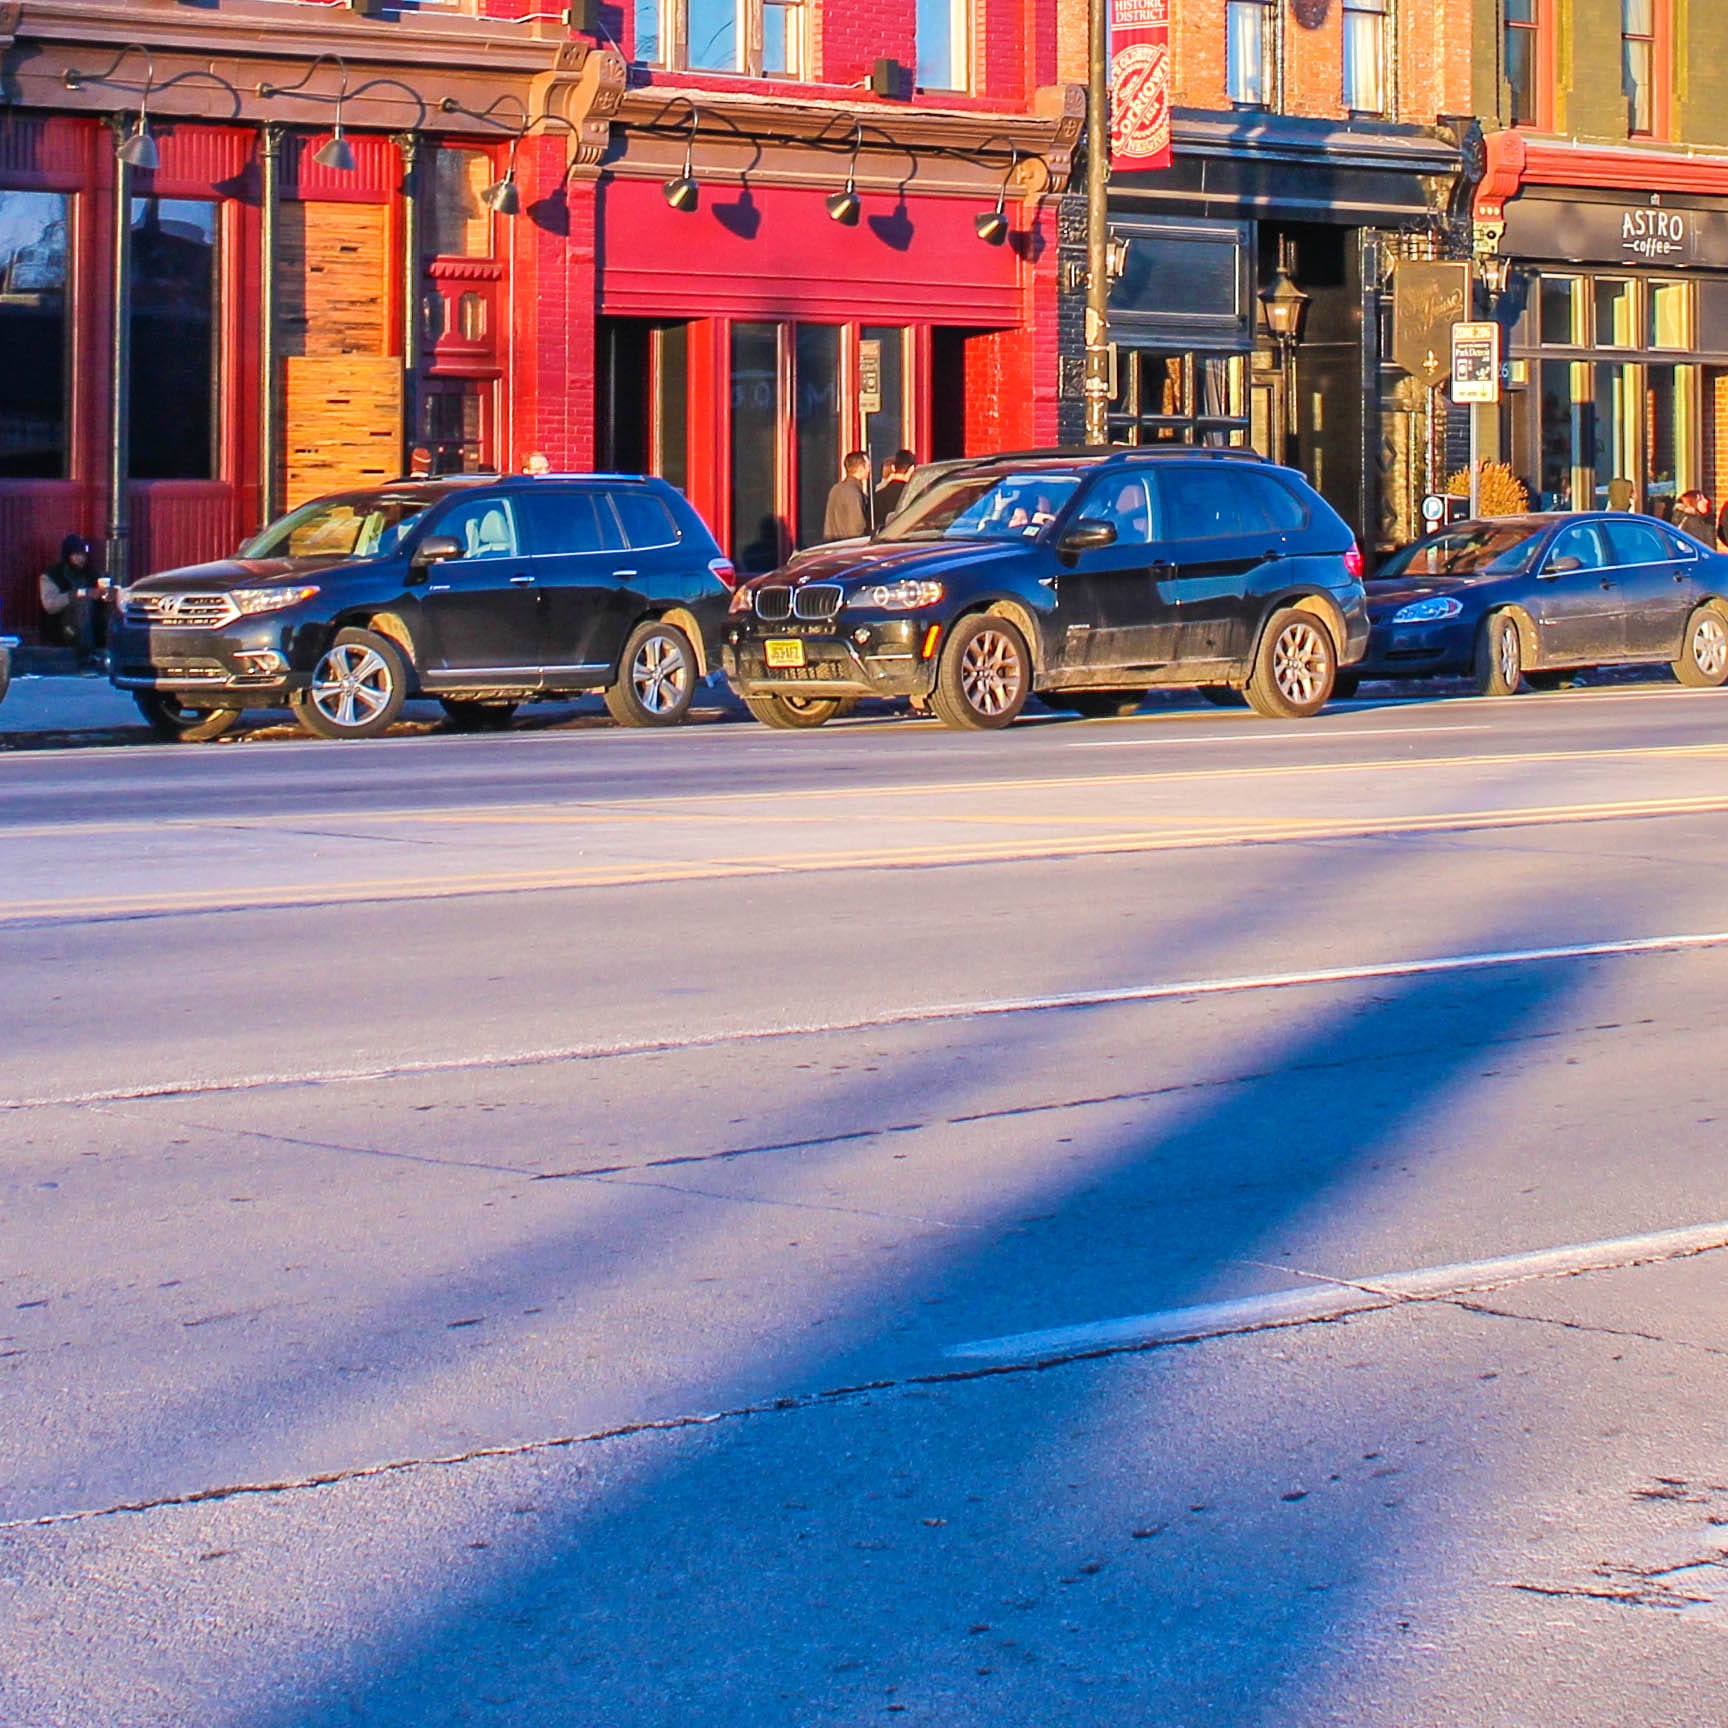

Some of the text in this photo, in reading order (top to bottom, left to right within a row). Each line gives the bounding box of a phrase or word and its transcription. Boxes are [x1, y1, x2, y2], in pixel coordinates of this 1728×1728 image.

[1115, 8, 1165, 23] DISTRICT
[1623, 210, 1684, 241] ASTRO
[1633, 238, 1671, 258] coffee
